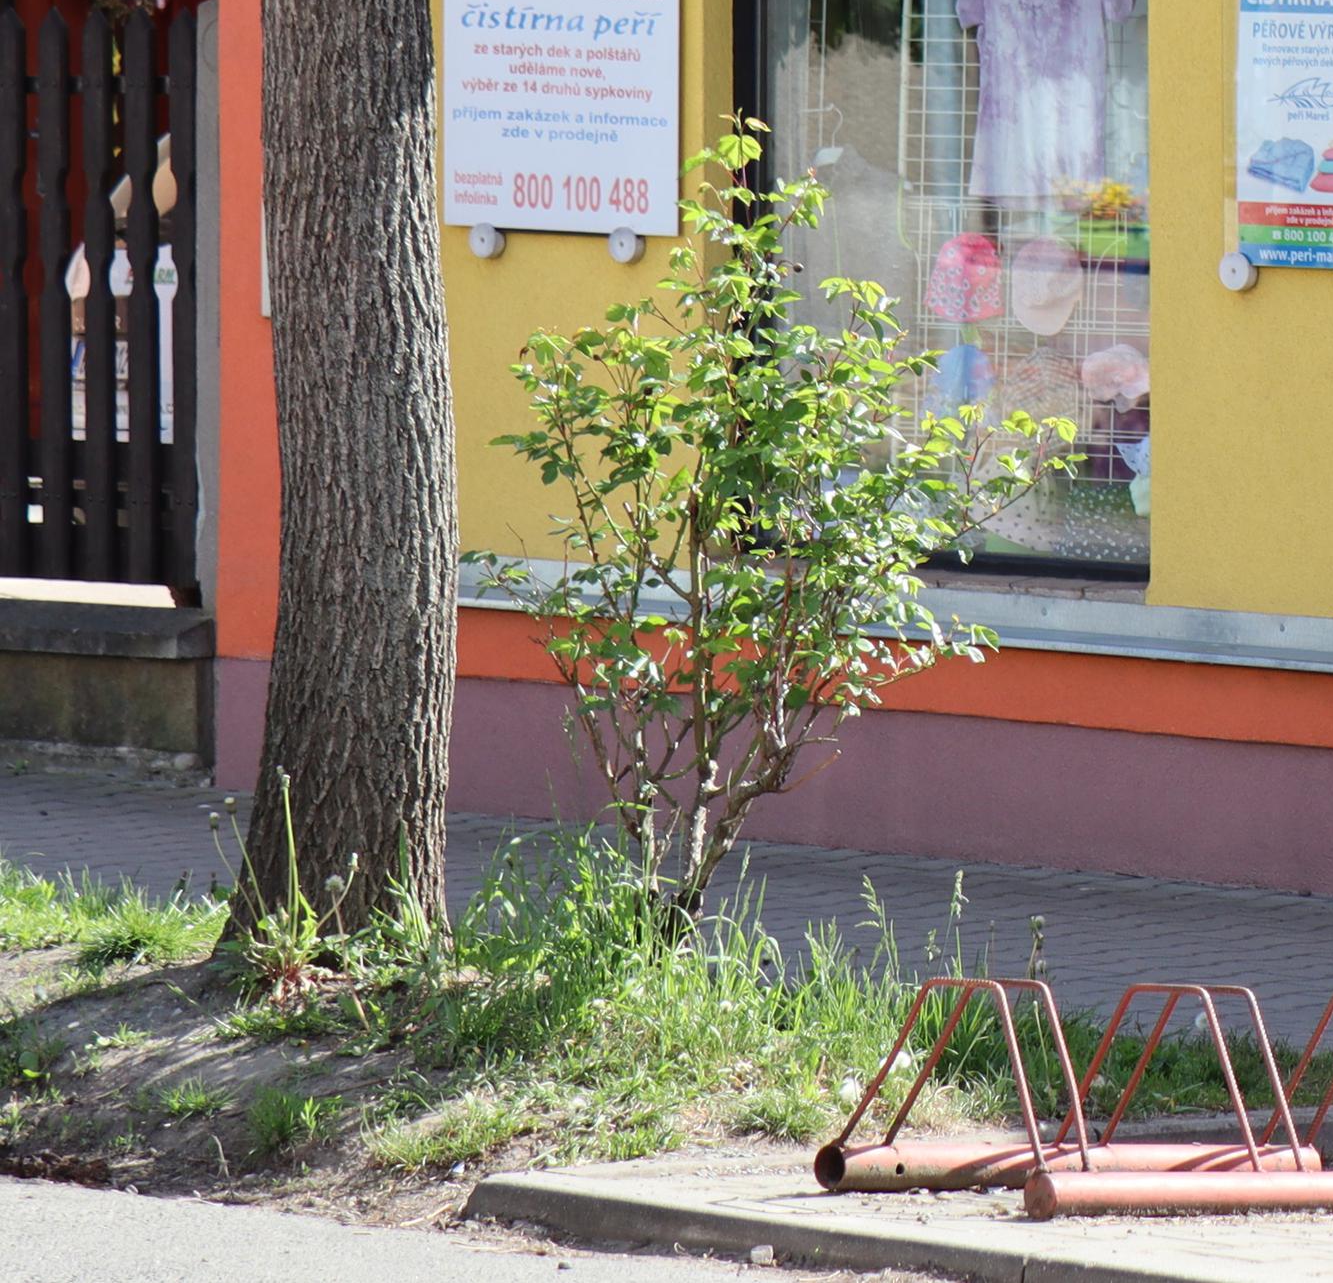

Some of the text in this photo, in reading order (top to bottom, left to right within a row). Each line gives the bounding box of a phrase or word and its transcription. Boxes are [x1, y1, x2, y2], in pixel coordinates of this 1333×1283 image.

[461, 3, 662, 40] čistírna peří
[1252, 20, 1305, 40] PÉŘOVÉ
[474, 43, 641, 62] ze starých dek a polštářů
[509, 63, 606, 81] uděláme nové,
[462, 78, 498, 94] výběr
[503, 83, 518, 92] ze
[523, 81, 537, 93] 14
[541, 82, 581, 96] druhů
[452, 105, 668, 127] příjem zakázek a informace
[502, 126, 618, 144] zde v prodejně
[454, 171, 503, 187] bezplatná
[454, 192, 497, 205] infolinka
[513, 172, 649, 214] 800 100 488
[1284, 229, 1304, 242] 800
[1308, 230, 1326, 242] 100
